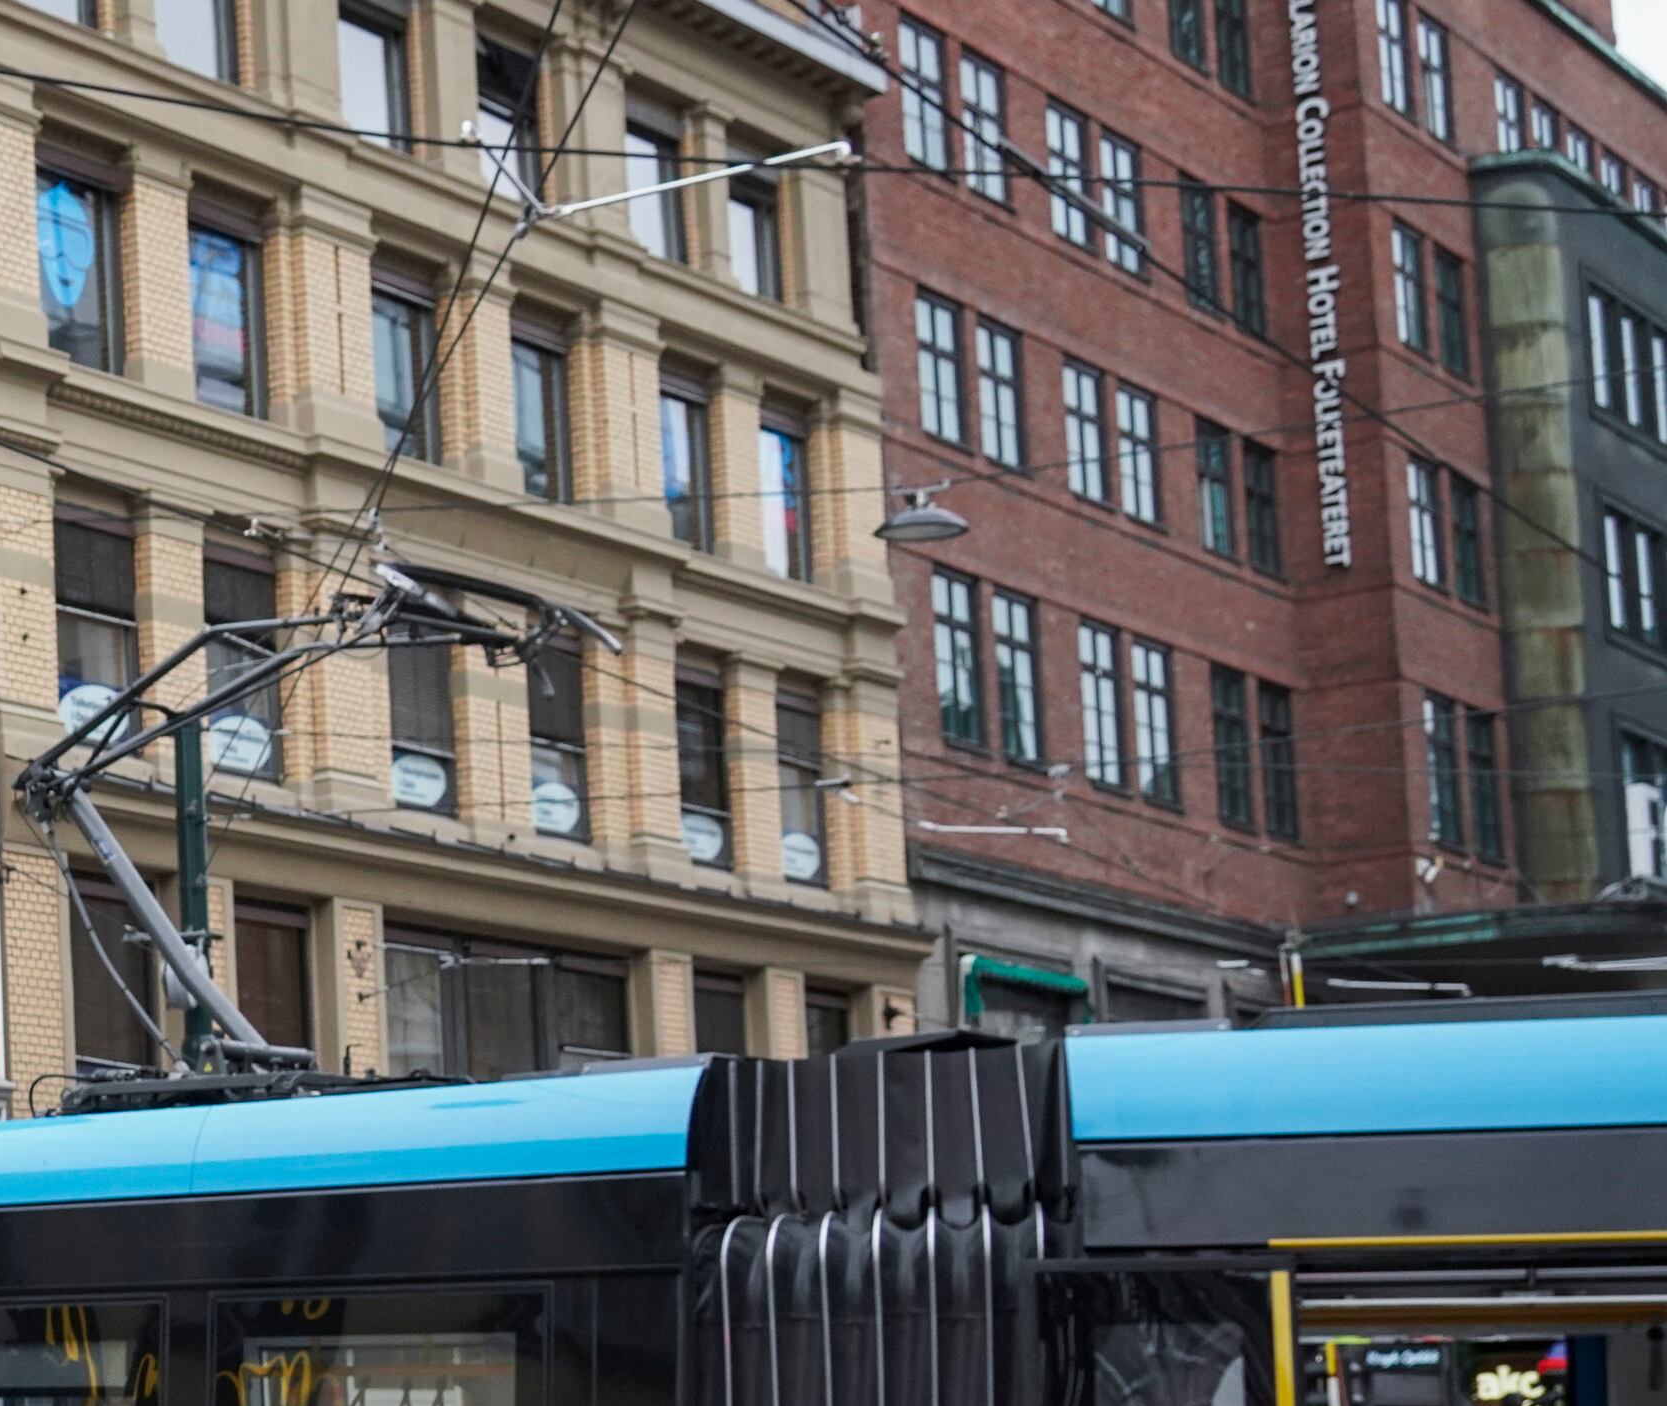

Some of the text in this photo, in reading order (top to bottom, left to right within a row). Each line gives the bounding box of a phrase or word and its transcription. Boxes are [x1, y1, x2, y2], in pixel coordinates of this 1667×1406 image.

[1288, 0, 1352, 568] LARION COLLECTION HOTEL FOLKETEATERET
